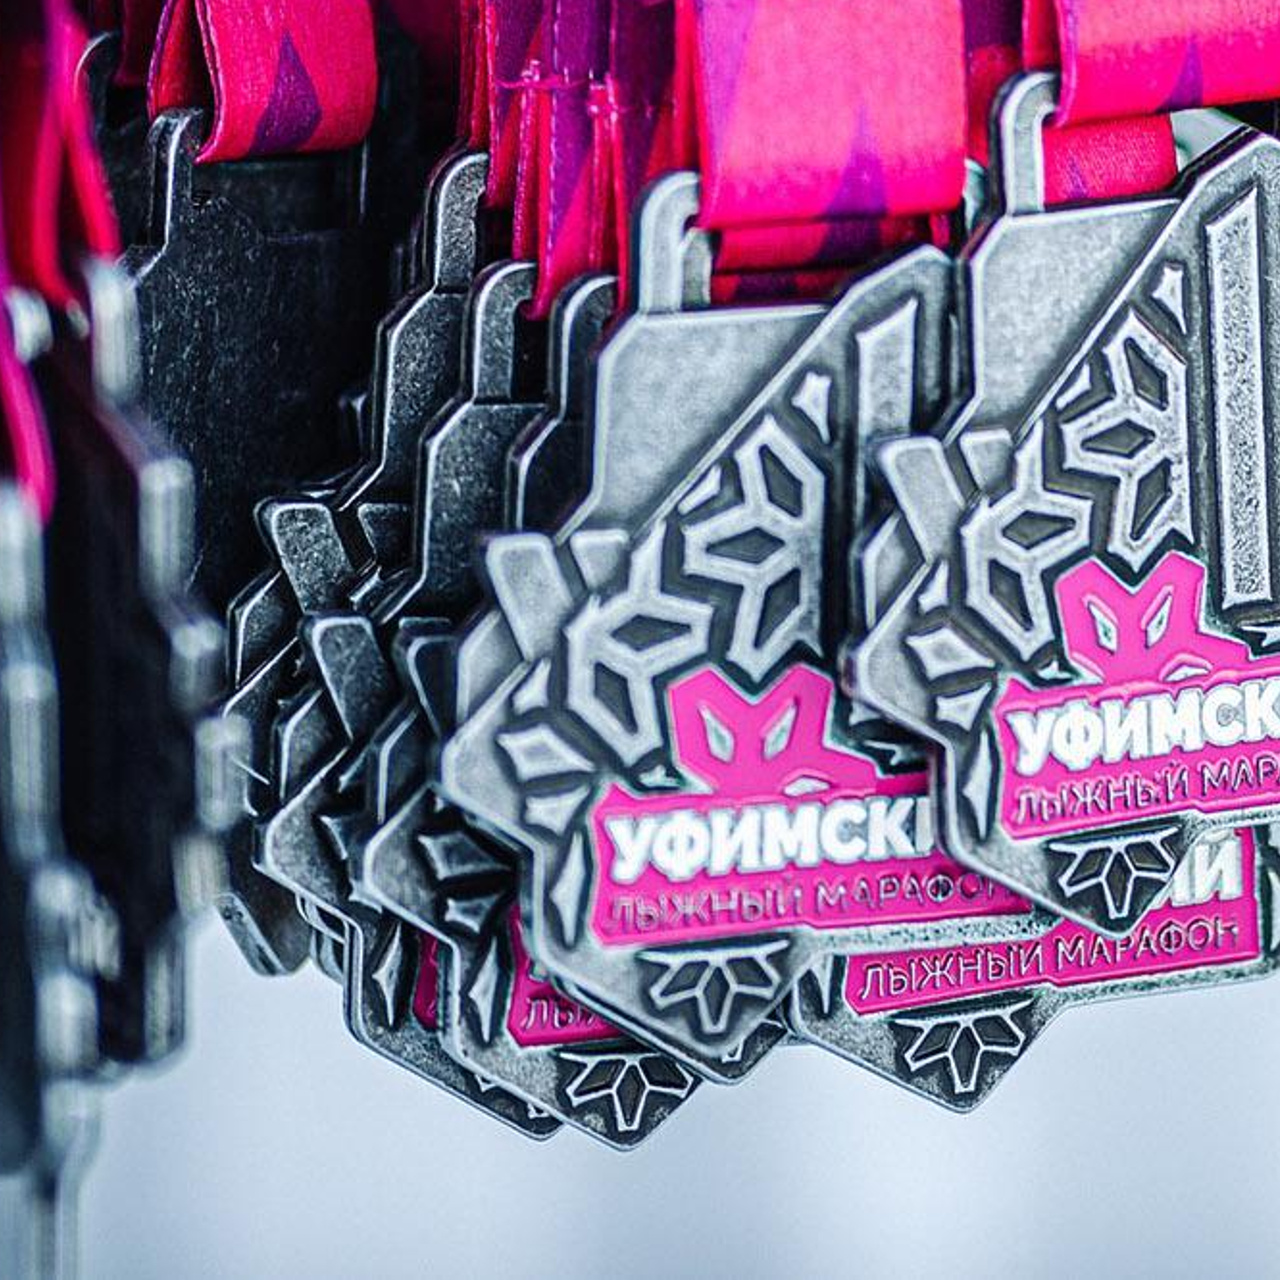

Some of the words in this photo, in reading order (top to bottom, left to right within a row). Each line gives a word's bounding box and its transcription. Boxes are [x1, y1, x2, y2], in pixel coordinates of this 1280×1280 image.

[1015, 762, 1190, 824] ЛЫЖНЫЙ
[860, 942, 1044, 1001] ЛЫЖНЫЙ
[1056, 917, 1240, 972] МАРАФОН
